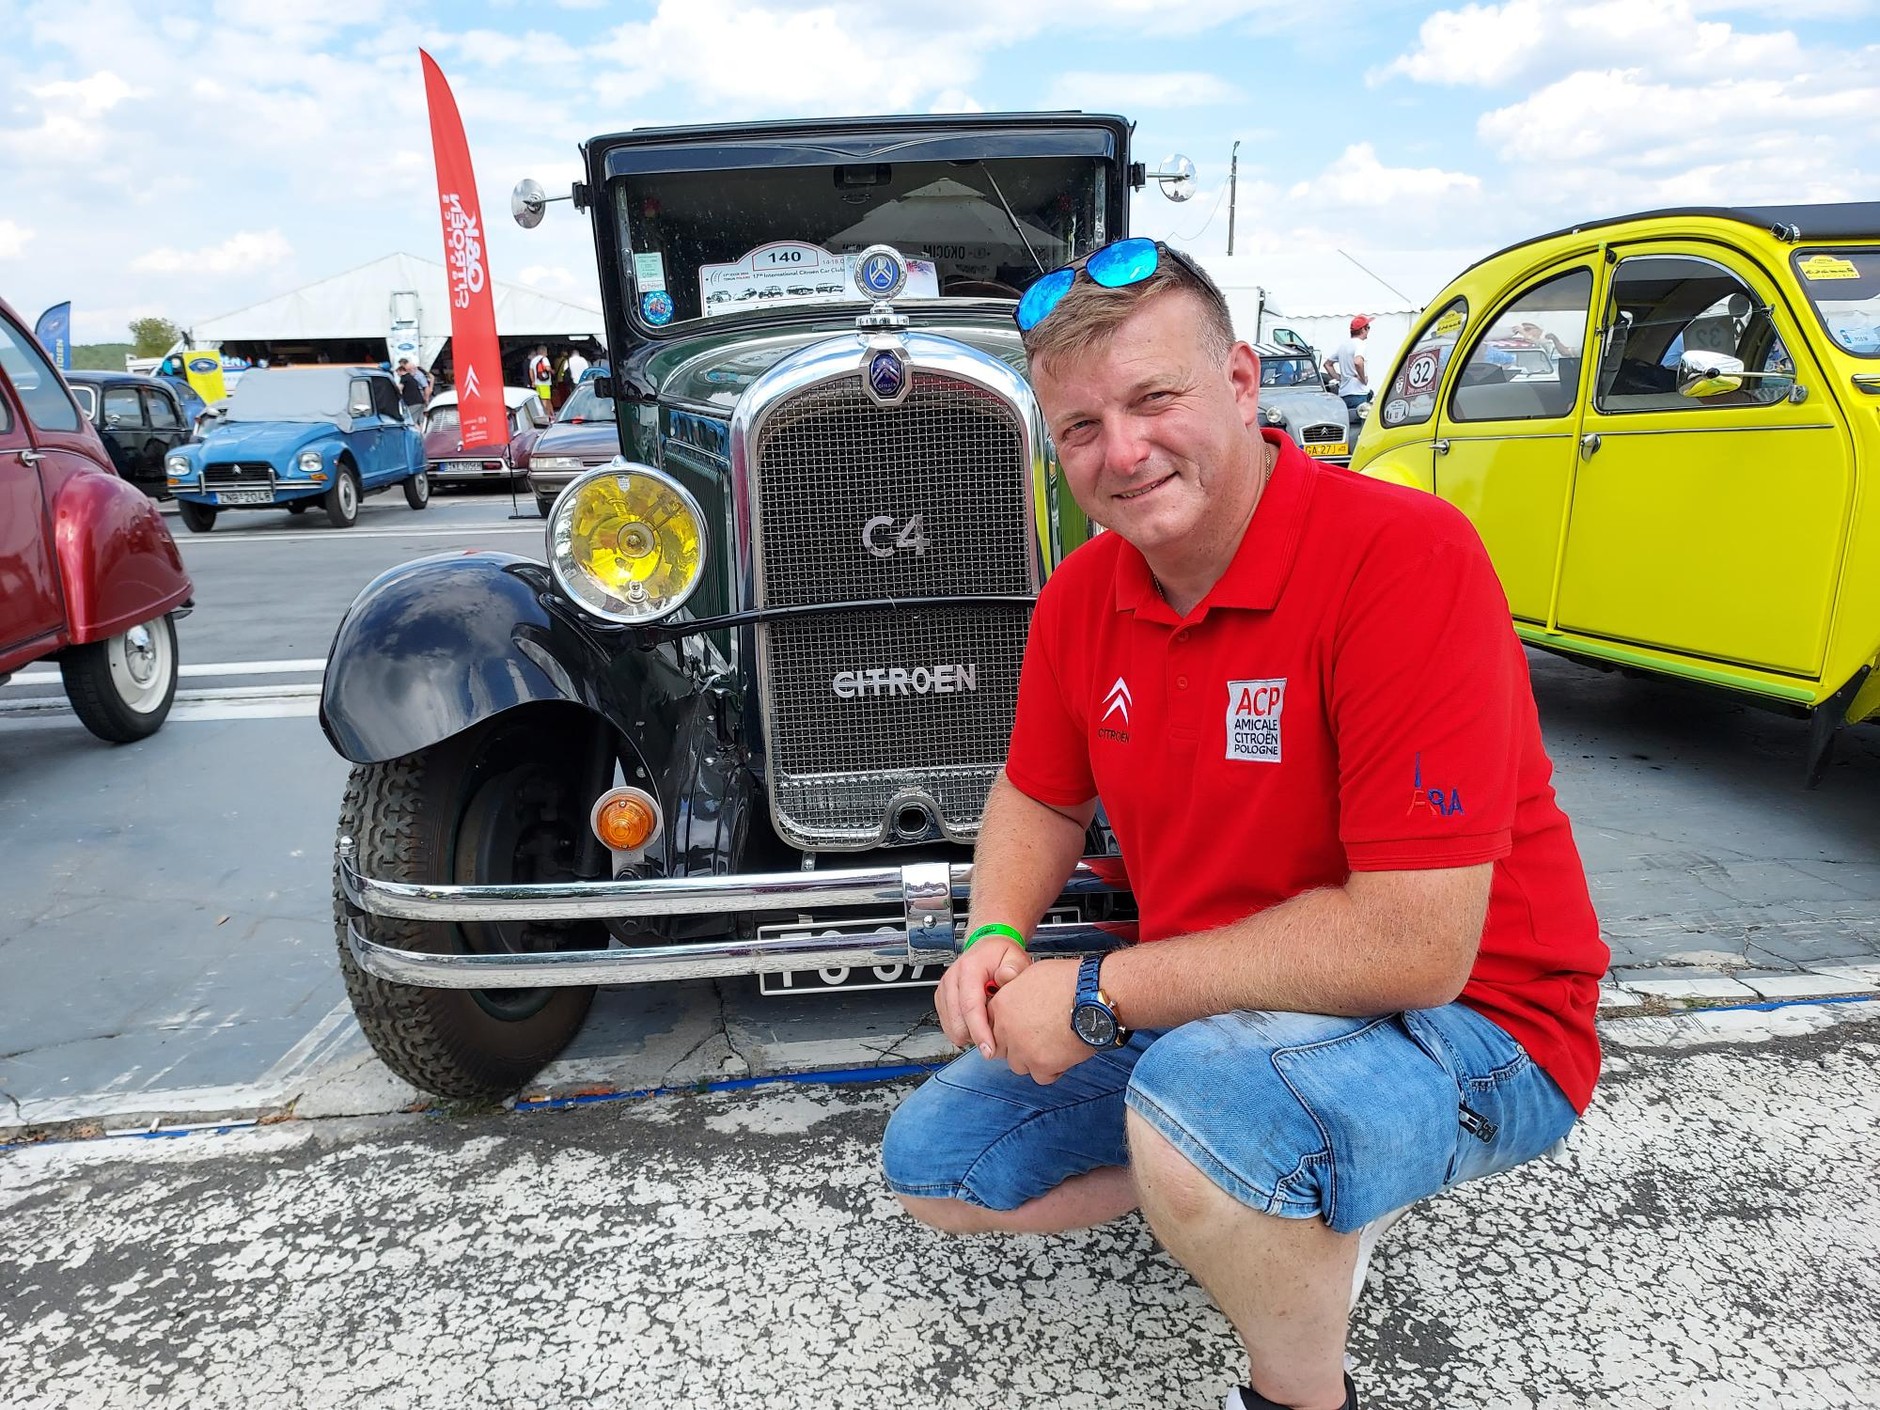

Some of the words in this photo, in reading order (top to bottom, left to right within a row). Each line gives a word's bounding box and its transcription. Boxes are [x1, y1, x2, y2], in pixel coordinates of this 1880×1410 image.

[768, 251, 801, 263] 140
[763, 270, 798, 278] International
[1413, 360, 1430, 384] 32
[862, 514, 931, 557] C4
[832, 664, 977, 698] CITROEN
[1236, 687, 1280, 716] ACP
[1234, 718, 1278, 731] AMICALE
[1234, 730, 1278, 745] CITROËN
[1234, 744, 1278, 755] POLOGNE
